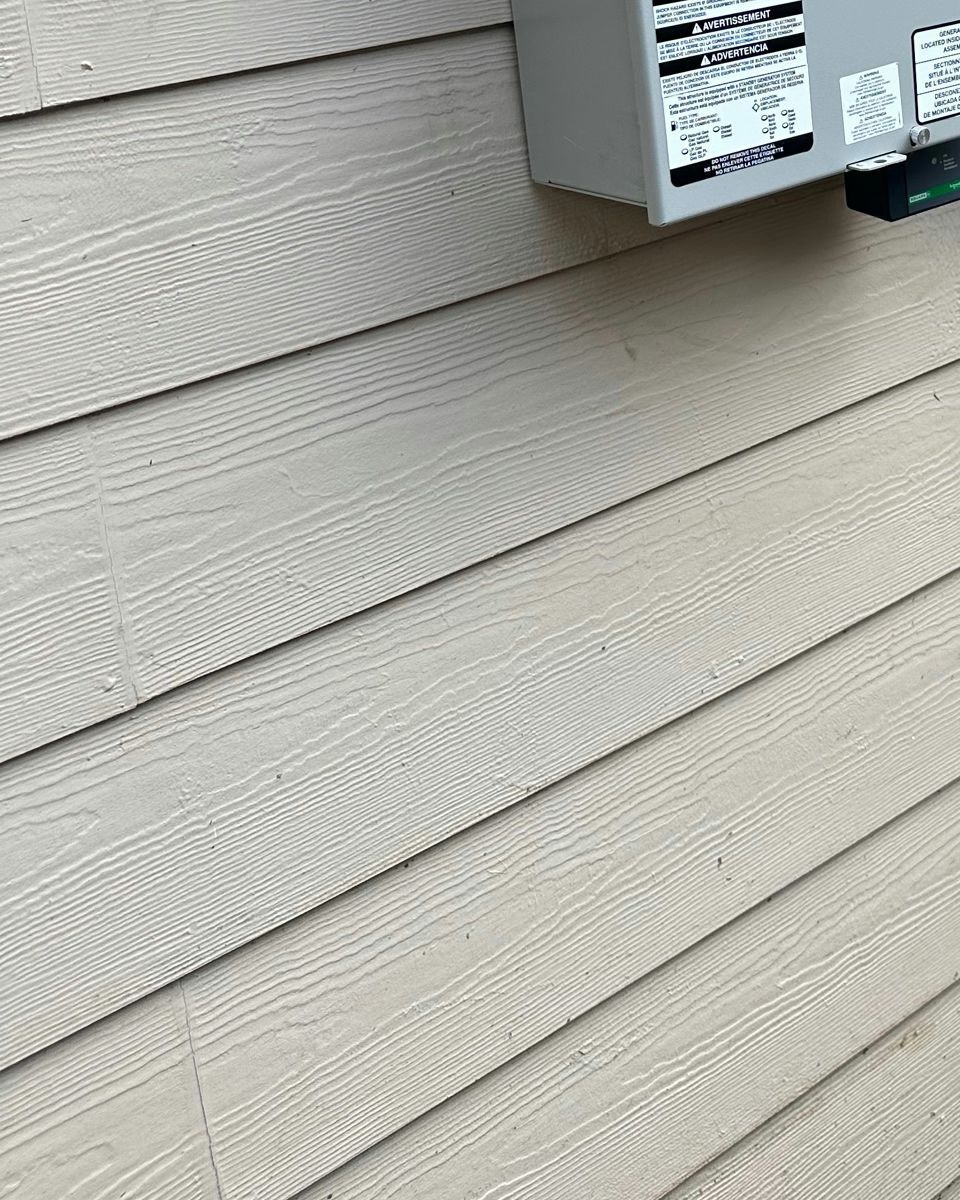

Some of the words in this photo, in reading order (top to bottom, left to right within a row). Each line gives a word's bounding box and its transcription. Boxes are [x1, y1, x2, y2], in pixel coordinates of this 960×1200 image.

[702, 10, 771, 31] AVERTISSEMENT
[921, 39, 945, 50] LOCATED
[710, 43, 768, 63] ADVERTENCIA
[925, 81, 933, 89] DE
[934, 96, 957, 108] UBICADA
[924, 111, 930, 119] DE
[932, 105, 955, 117] MONTAJE
[720, 155, 730, 163] NOT
[730, 150, 750, 160] REMOVE
[750, 147, 760, 155] THIS
[761, 143, 776, 152] DECAL
[711, 163, 721, 171] PAS
[722, 157, 743, 168] ENLEVER
[744, 153, 759, 162] CETTE
[715, 168, 723, 176] NO
[723, 163, 744, 174] RETIRAR
